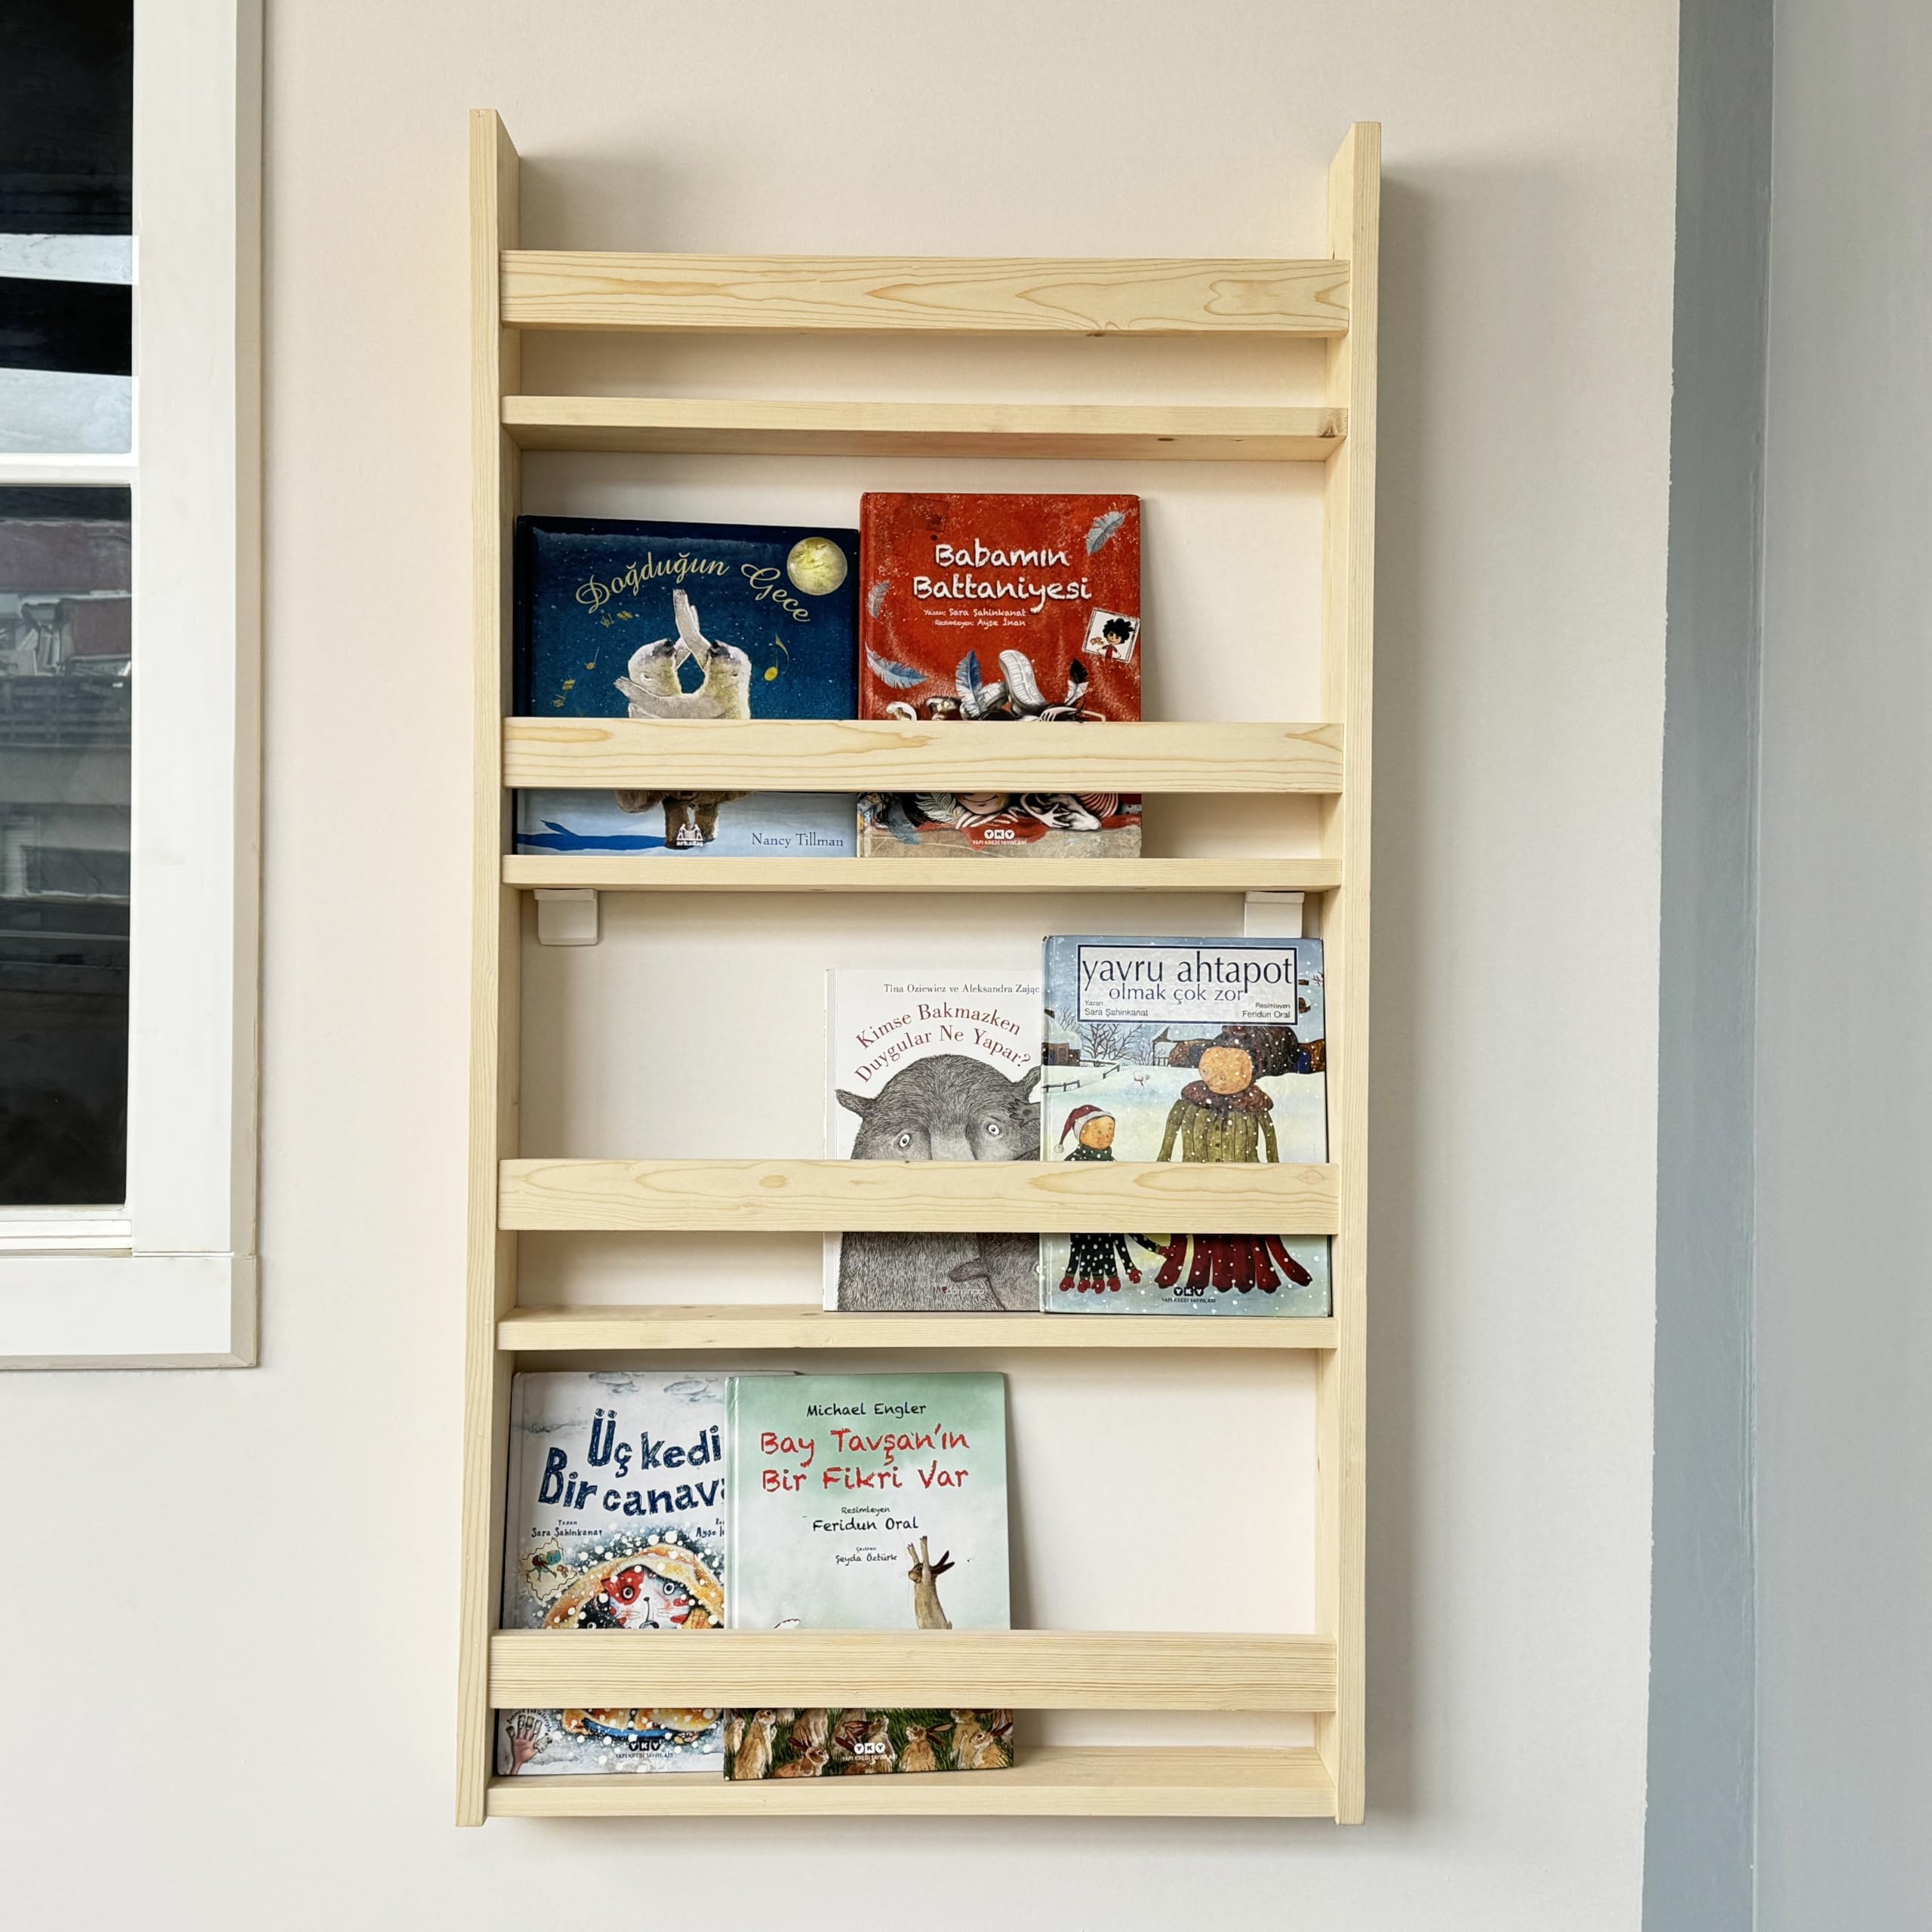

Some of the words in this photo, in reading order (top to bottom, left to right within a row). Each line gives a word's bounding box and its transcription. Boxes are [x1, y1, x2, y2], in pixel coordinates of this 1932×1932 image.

[935, 538, 1070, 568] Babamın
[575, 551, 730, 614] Doğduğun
[741, 563, 811, 623] Gece
[912, 574, 1092, 614] Battaniyesi
[949, 608, 969, 617] Sara
[752, 832, 791, 849] Nancy
[796, 832, 844, 848] Tillman
[985, 830, 1014, 838] YKY
[1082, 959, 1163, 992] yavru
[1177, 951, 1293, 993] ahtapot
[884, 983, 903, 993] Tina
[962, 983, 1013, 993] Aleksandra
[1109, 983, 1166, 1000] olmak
[1174, 986, 1207, 1004] çok
[1214, 989, 1244, 1001] zor
[1084, 1008, 1103, 1016] Sara
[1242, 1010, 1272, 1018] Feridun
[855, 1013, 912, 1050] Kimse
[917, 1001, 1020, 1036] Bakmazken
[854, 1031, 932, 1083] Duygular
[940, 1025, 964, 1041] Ne
[973, 1028, 1031, 1067] Yapar?
[1174, 1287, 1203, 1296] YKY
[806, 1402, 866, 1417] Michael
[875, 1401, 927, 1418] Engler
[587, 1407, 632, 1478] Üç
[641, 1425, 722, 1470] kedi
[761, 1431, 815, 1468] Bay
[538, 1446, 598, 1510] Bir
[602, 1478, 724, 1517] canav
[762, 1469, 808, 1492] Bir
[823, 1466, 903, 1490] Fikri
[918, 1460, 969, 1489] Var
[841, 1506, 891, 1516] Resimleyen
[531, 1527, 551, 1538] Sara
[813, 1517, 878, 1532] Feridun
[885, 1517, 919, 1531] Oral
[835, 1553, 862, 1566] Şeyda
[866, 1552, 897, 1562] Öztürk
[629, 1742, 660, 1750] YKY
[855, 1743, 884, 1752] YKY
